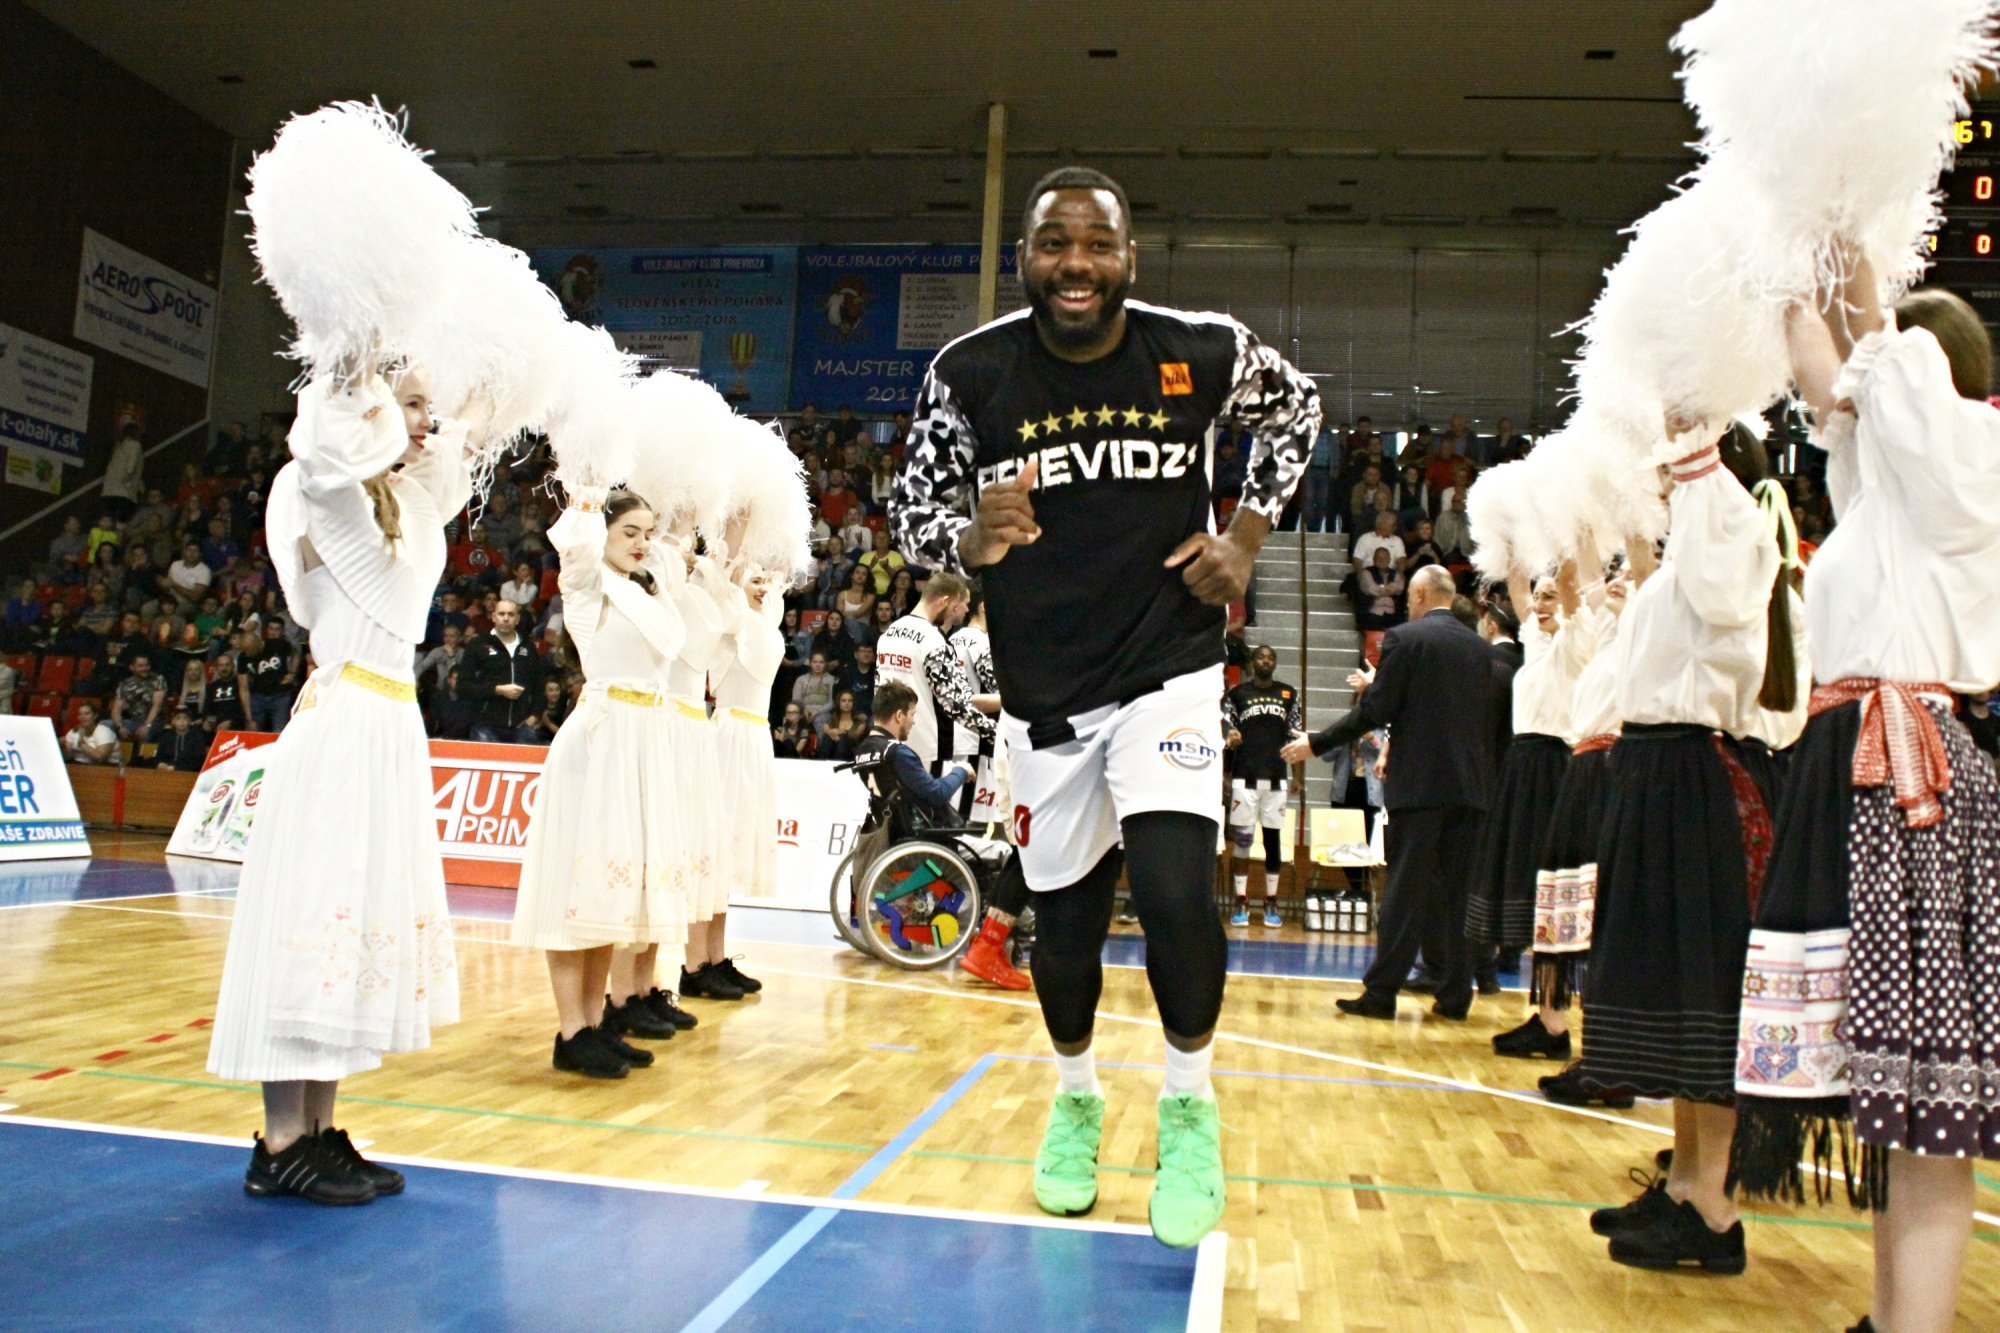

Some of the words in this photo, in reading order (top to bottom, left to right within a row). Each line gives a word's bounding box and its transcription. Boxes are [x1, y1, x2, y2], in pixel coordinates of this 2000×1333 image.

[807, 251, 917, 268] VOLEJBALOVÝ
[922, 254, 963, 268] KLUB
[814, 359, 915, 377] MAJSTER
[1158, 741, 1217, 759] msm
[26, 825, 86, 841] ZDRAVIE
